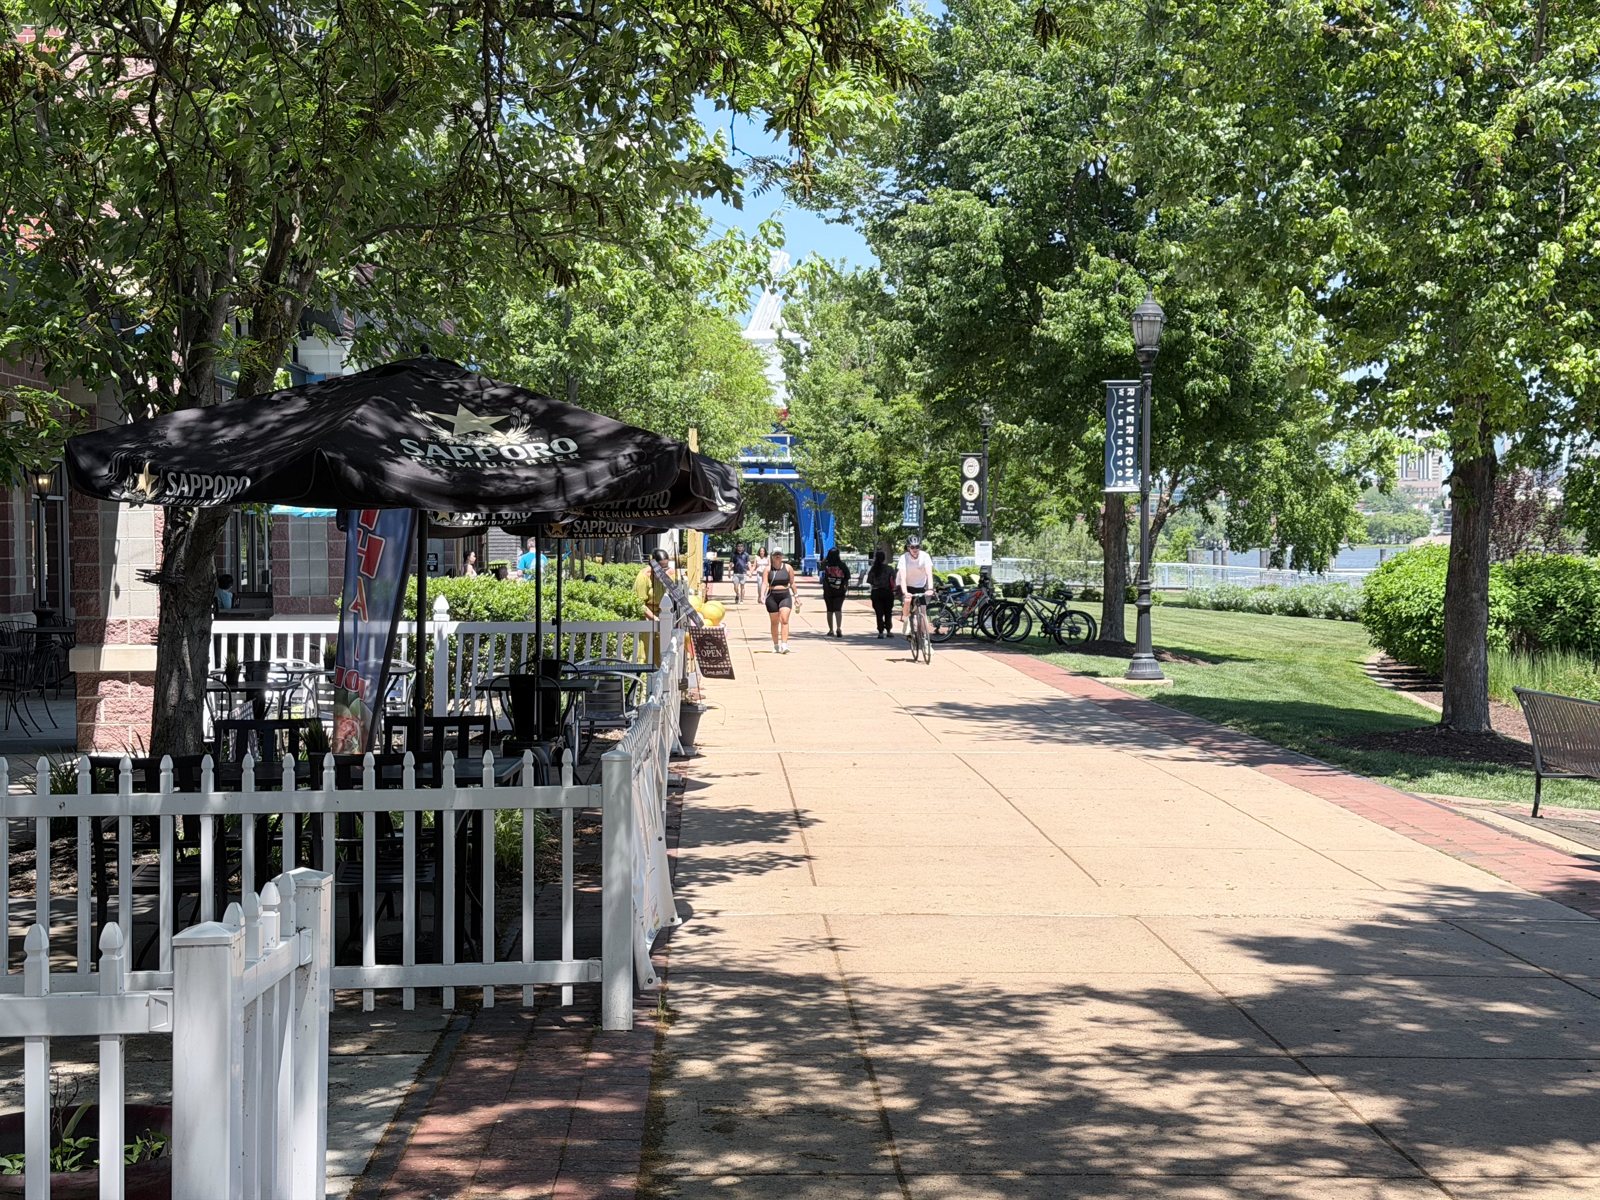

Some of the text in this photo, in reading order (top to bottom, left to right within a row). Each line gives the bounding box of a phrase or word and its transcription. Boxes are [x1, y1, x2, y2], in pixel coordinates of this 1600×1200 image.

[1116, 388, 1125, 487] WILMINGTON
[1125, 387, 1136, 487] RIVERFRONT
[400, 437, 578, 461] SAPPORO
[411, 452, 582, 468] PREMIUM BEER
[165, 472, 251, 501] SAPPORO
[592, 509, 671, 518] PREMIUM BEER
[572, 520, 633, 533] SAPPORO
[700, 649, 723, 657] OPEN
